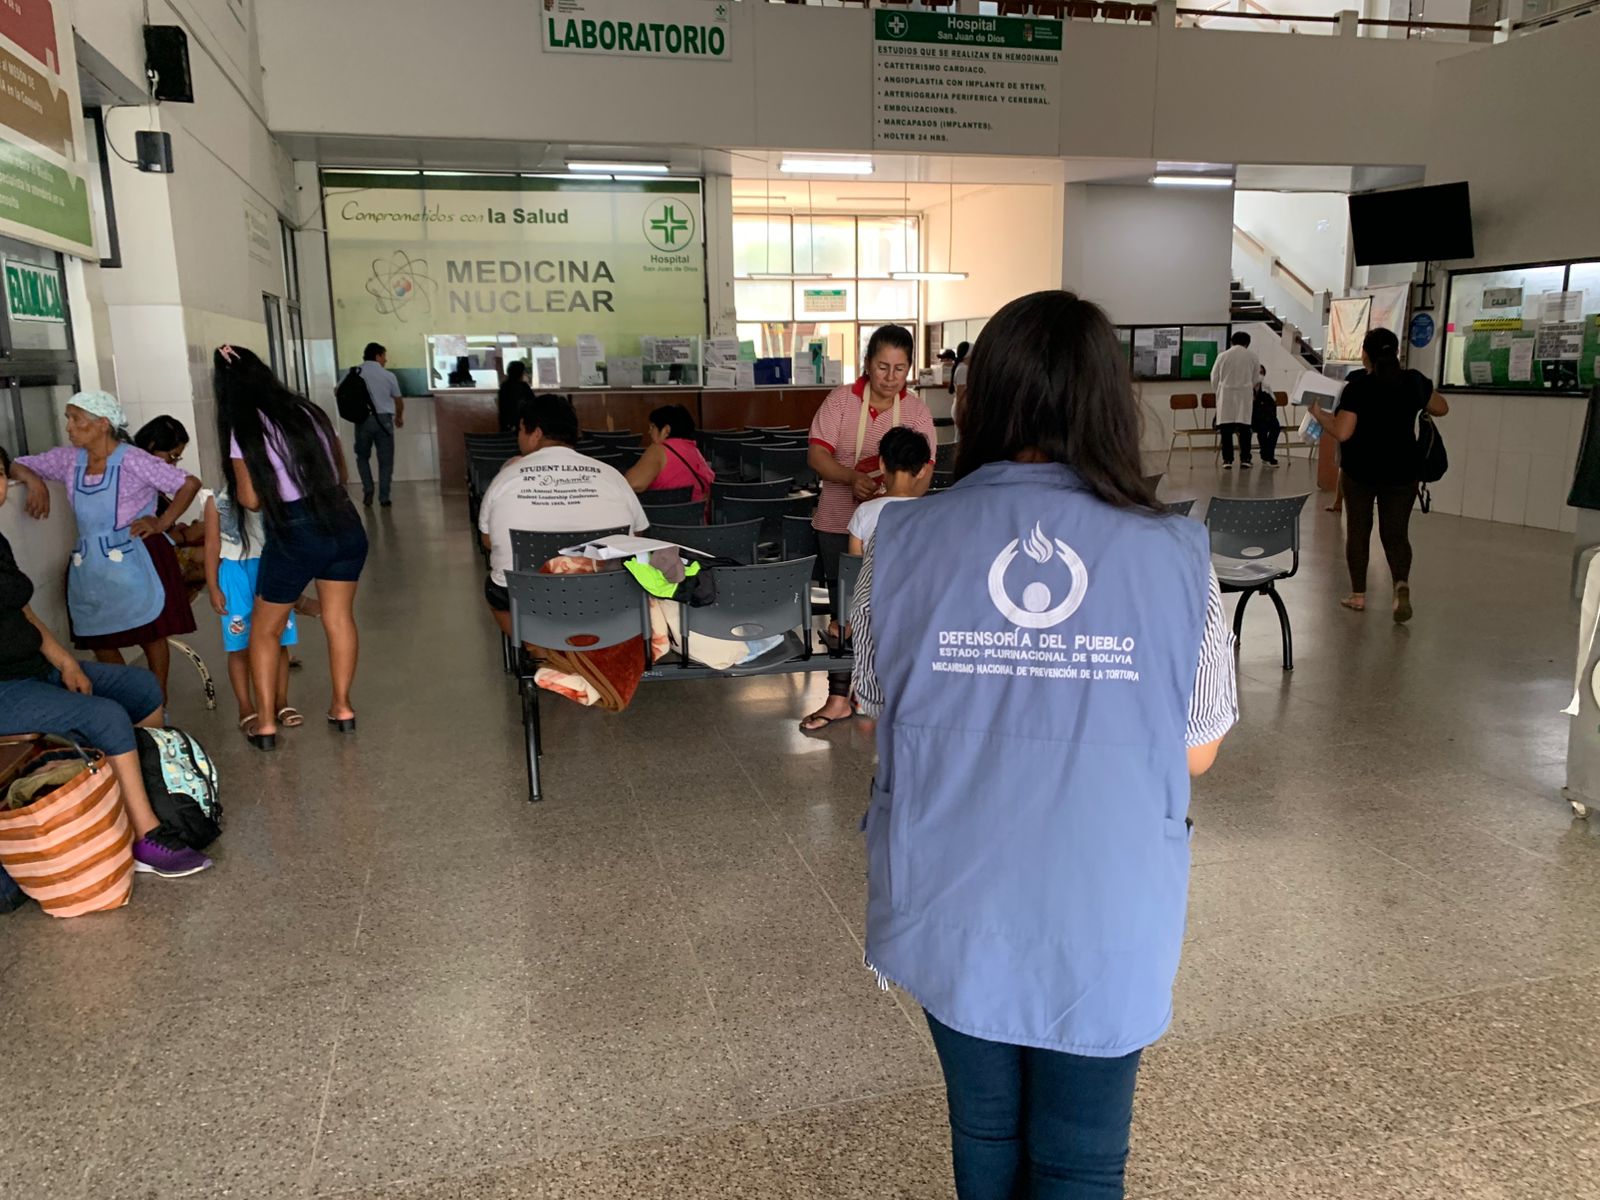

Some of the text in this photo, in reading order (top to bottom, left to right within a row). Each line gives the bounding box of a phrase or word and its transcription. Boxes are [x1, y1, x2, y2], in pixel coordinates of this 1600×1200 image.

[947, 17, 997, 32] Hospital
[548, 18, 725, 55] LABORATORIO
[937, 31, 1006, 43] San Juan de Dios
[878, 46, 1059, 63] ESTUDIOS QUE SE REALIZAN EN HEMODINAMIA
[884, 62, 987, 74] CATETERISMO CARDIACO.
[884, 76, 944, 86] ANGIOPLASTIA
[946, 79, 963, 87] CON
[966, 80, 1005, 89] IMPLANTE
[1020, 83, 1046, 91] STENT.
[884, 91, 949, 100] ARTERIOGRAFIA
[951, 93, 998, 103] PERIFERICA
[1007, 96, 1050, 105] CEREBRAL.
[884, 105, 957, 114] EMBOLIZACIONES.
[884, 119, 993, 131] MARCAPASOS (IMPLANTES).
[884, 132, 915, 141] HOLTER
[918, 133, 927, 141] 24
[341, 200, 569, 224] Comprometidos con la Salud
[650, 255, 690, 264] Hospital
[446, 260, 615, 284] MEDICINA
[449, 289, 615, 314] NUCLEAR
[520, 465, 601, 474] STUDENT LEADERS
[938, 627, 1135, 652] DEFENSORÍA DEL PUEBLO
[939, 647, 1133, 665] ESTADO PLURINACIONAL DE BOLIVIA
[932, 662, 1140, 681] MECANISMO NACIONAL DE PREVENCIÓN DE LA TORTURA
